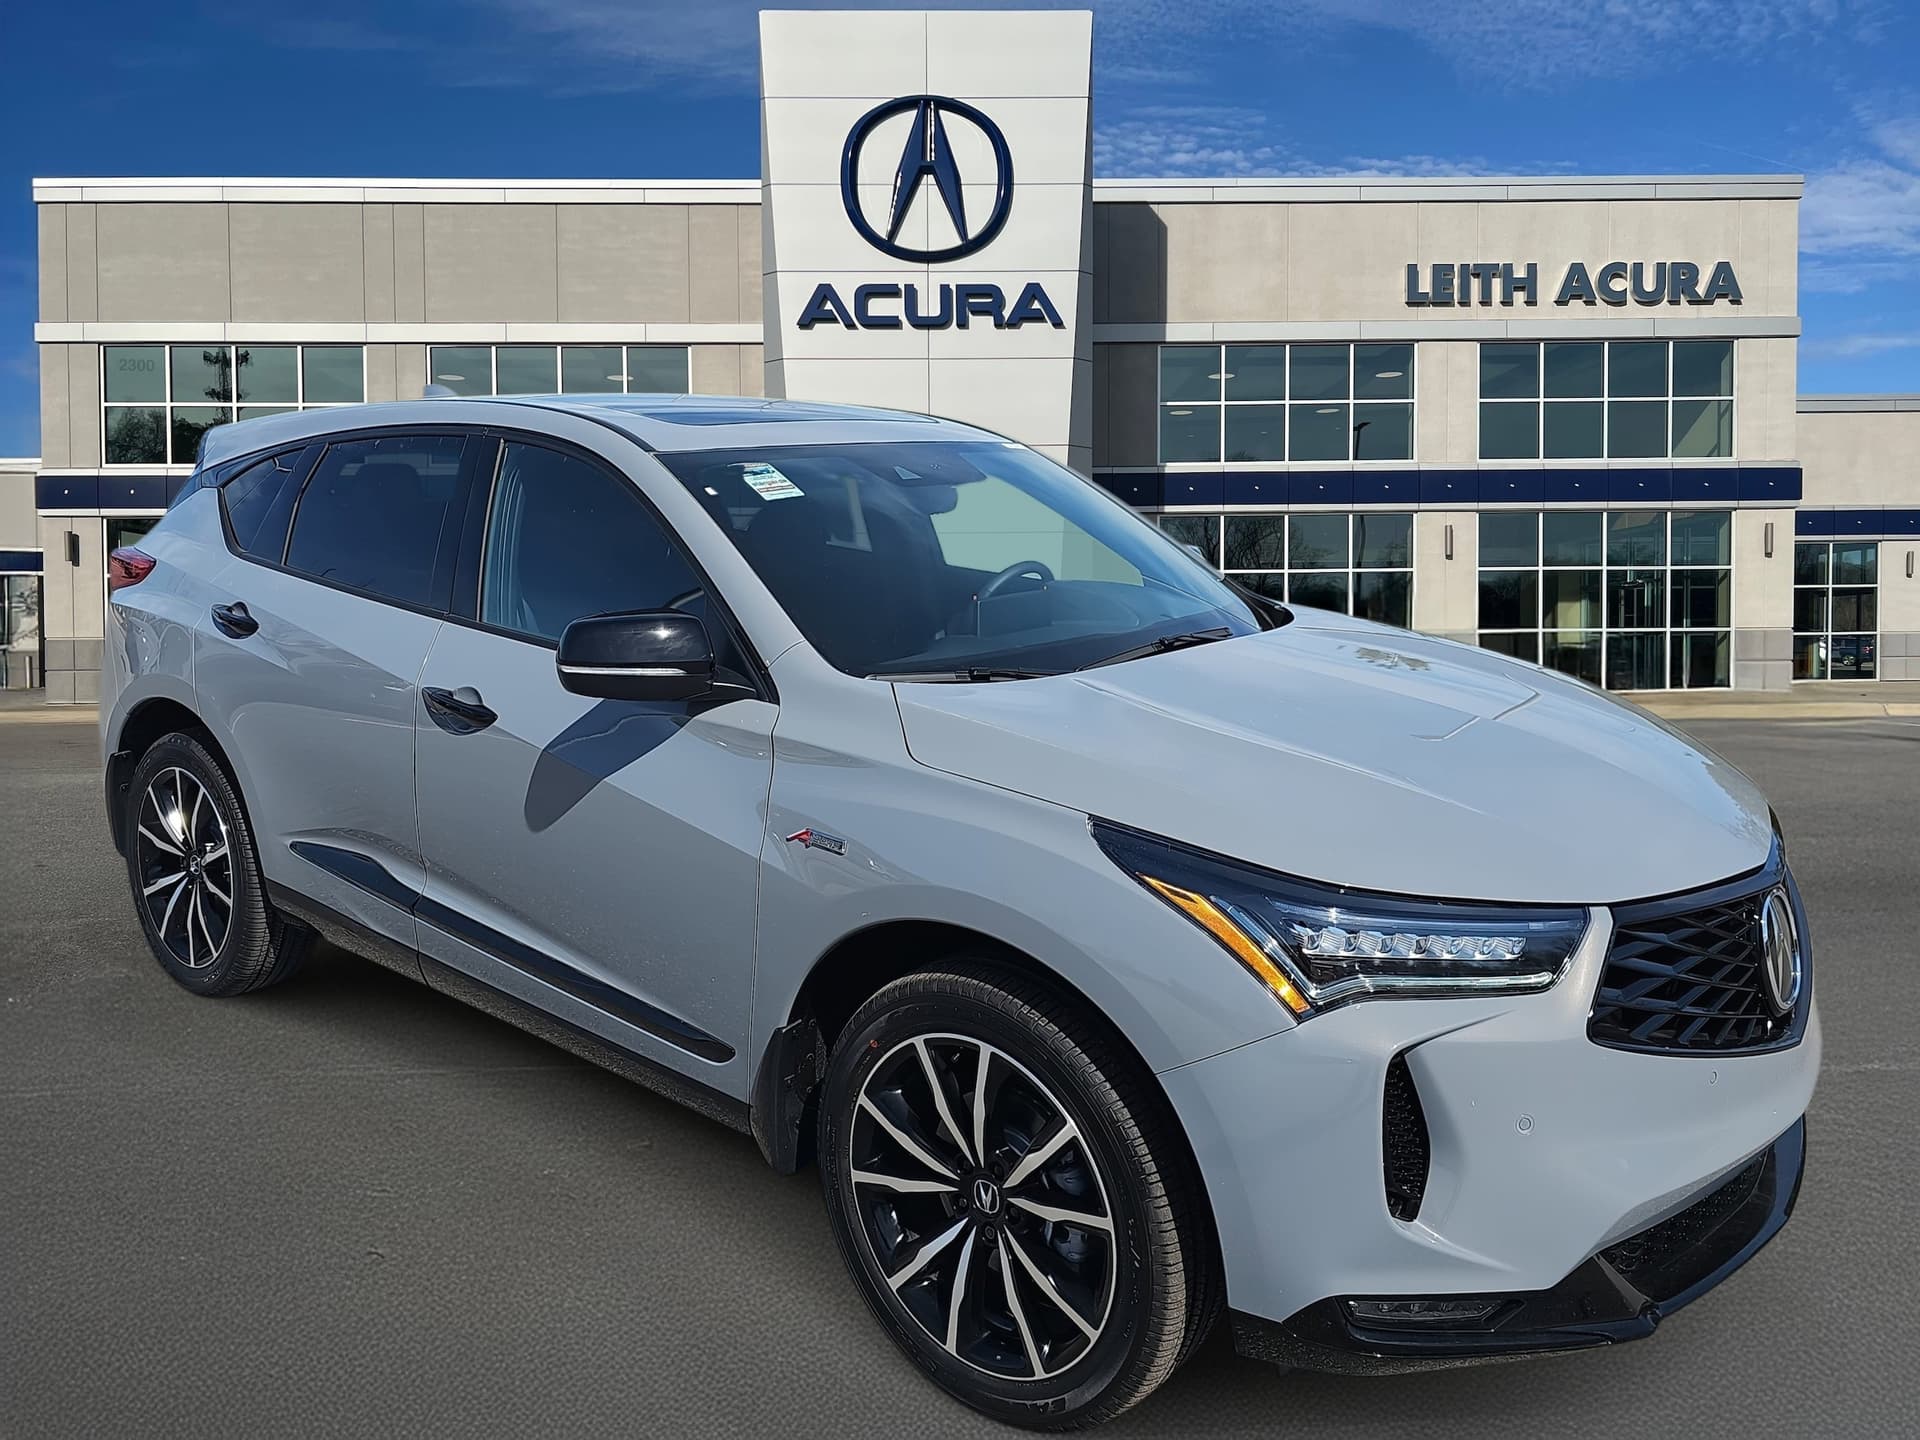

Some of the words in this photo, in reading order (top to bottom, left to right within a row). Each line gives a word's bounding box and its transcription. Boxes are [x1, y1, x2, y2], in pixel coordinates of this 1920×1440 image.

[1405, 262, 1538, 306] LEITH
[1554, 261, 1743, 306] ACURA
[797, 283, 1066, 330] ACURA
[119, 358, 155, 372] 2300
